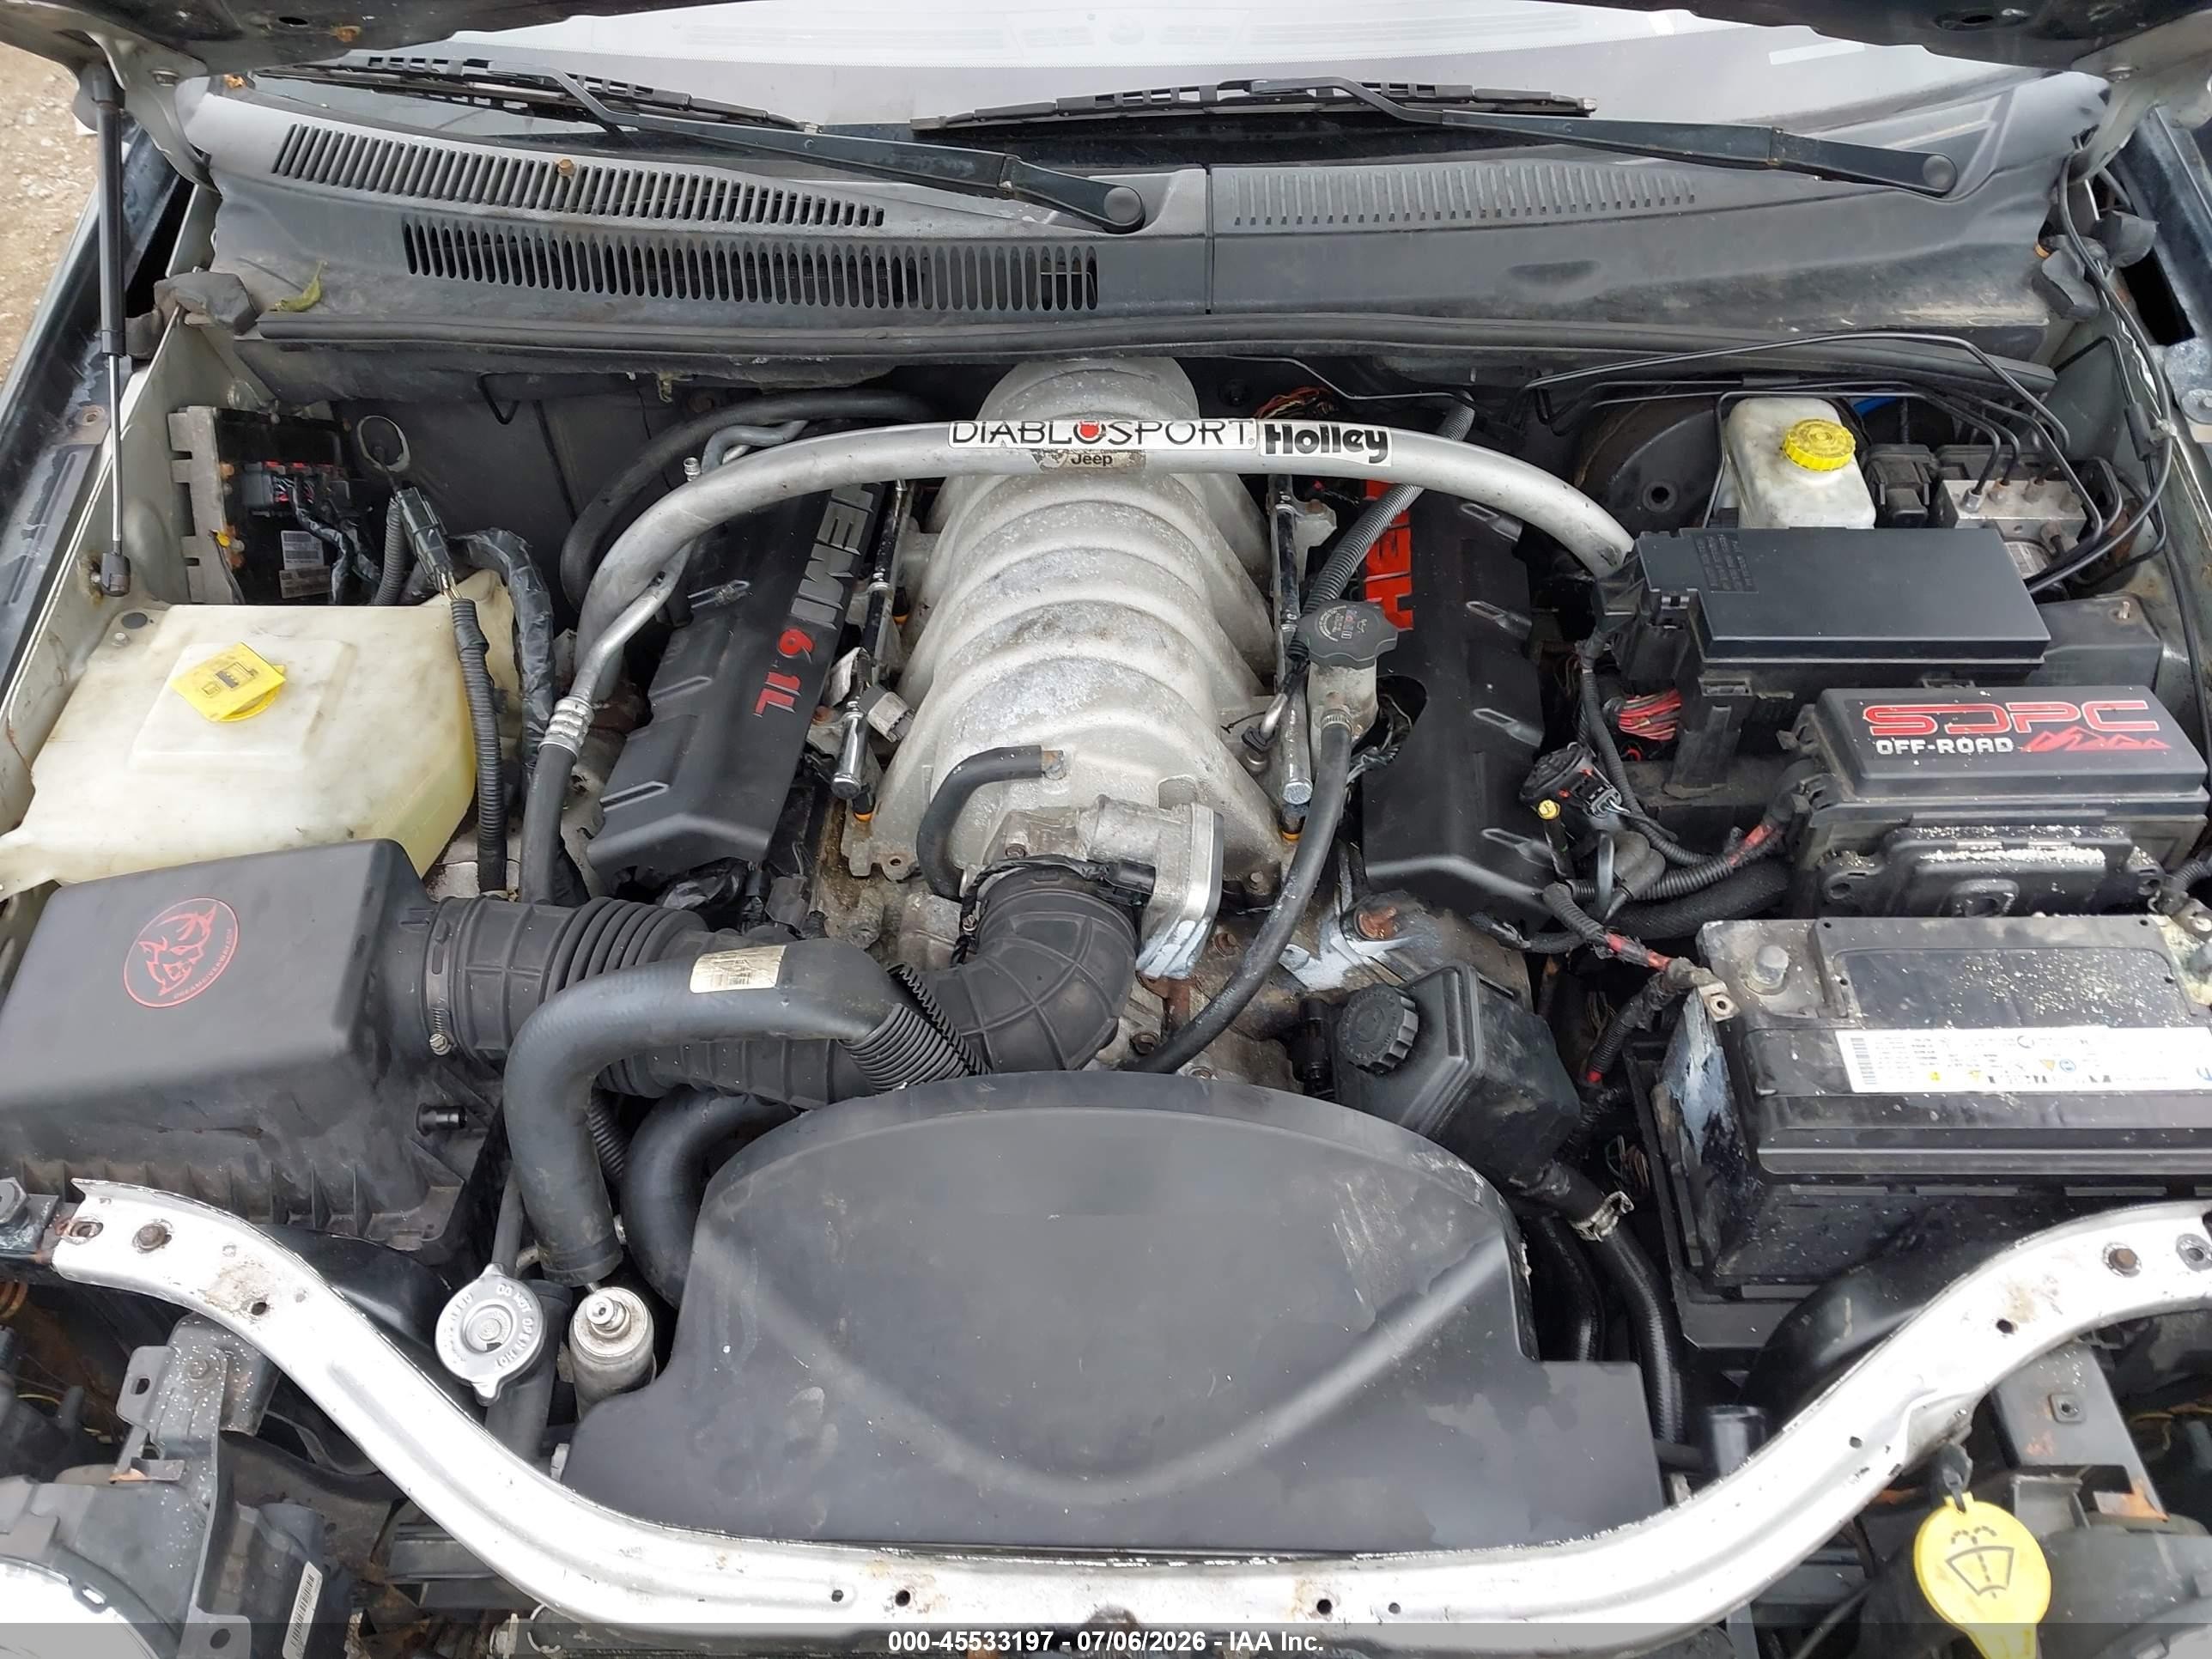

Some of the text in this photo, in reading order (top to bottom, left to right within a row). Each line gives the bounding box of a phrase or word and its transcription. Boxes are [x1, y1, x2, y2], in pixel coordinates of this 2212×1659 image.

[952, 420, 1254, 446] DIABLOSPORT
[1264, 423, 1389, 464] Holley
[1071, 453, 1114, 467] Jeep
[1875, 736, 2014, 755] OFF-ROAD
